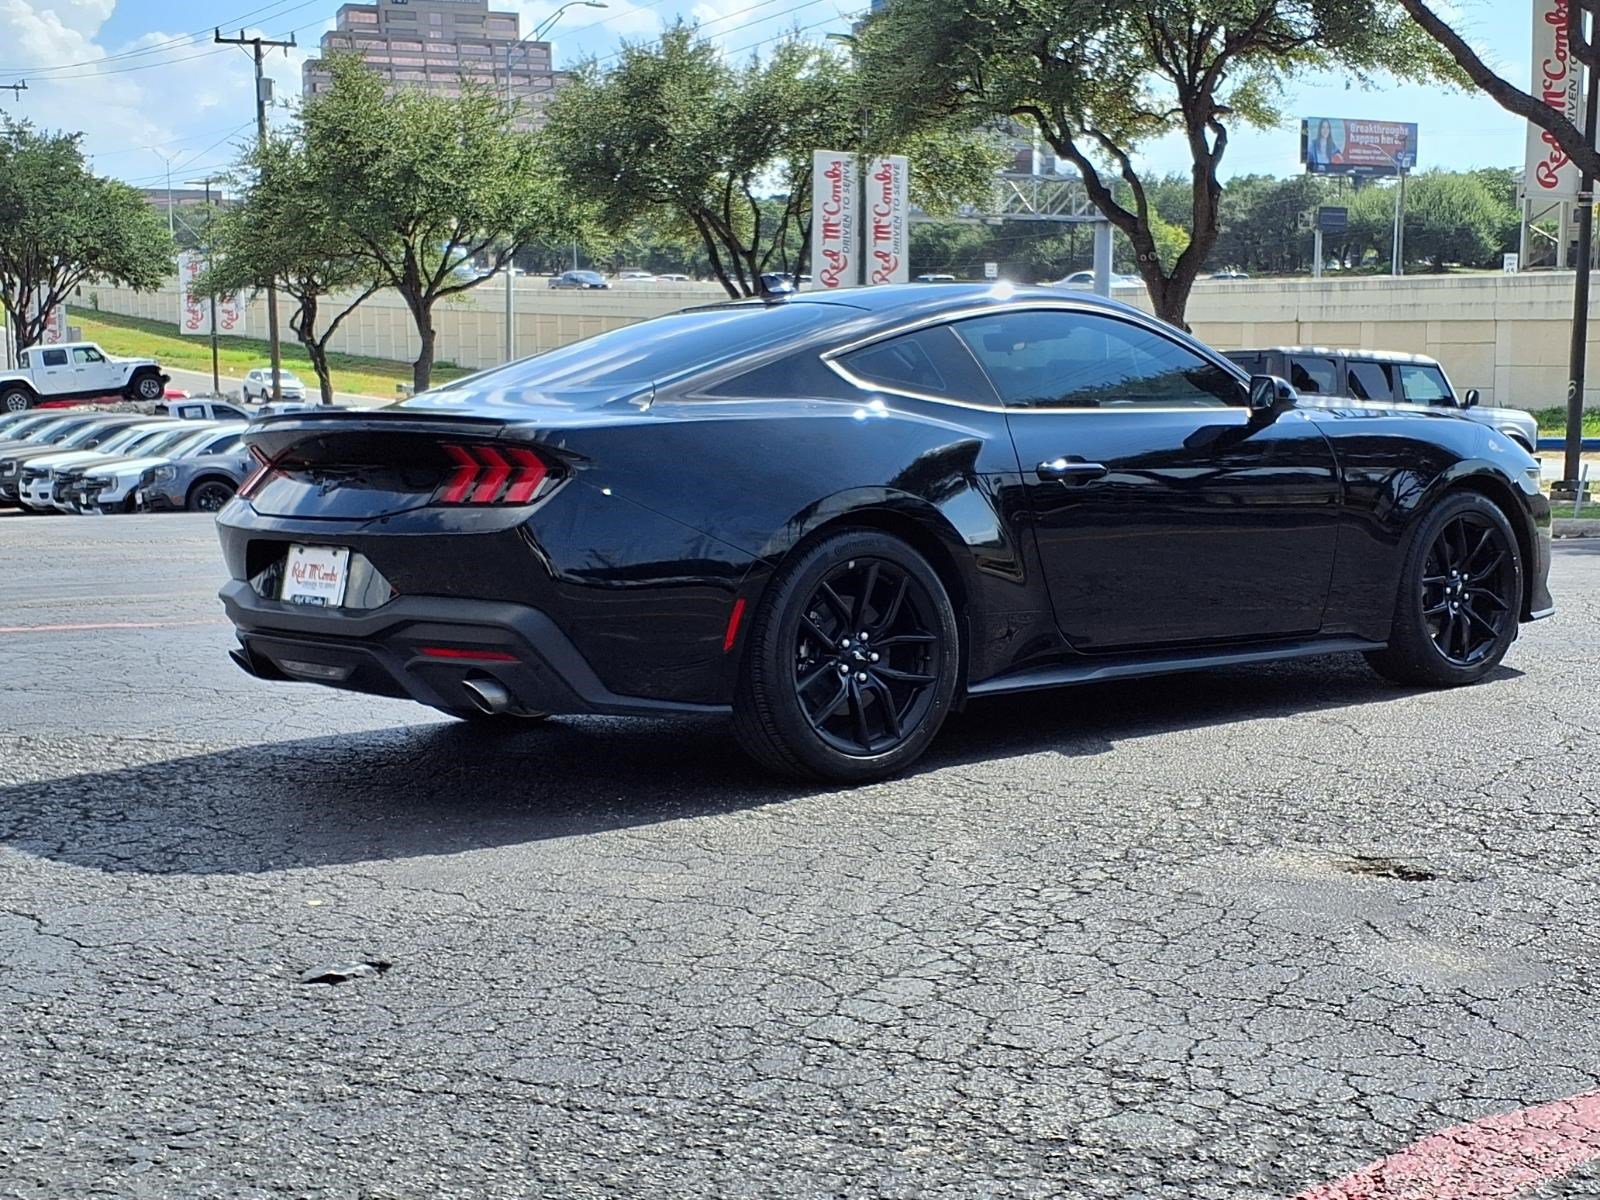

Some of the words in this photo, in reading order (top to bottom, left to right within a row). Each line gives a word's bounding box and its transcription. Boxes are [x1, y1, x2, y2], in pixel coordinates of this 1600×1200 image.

[1567, 80, 1578, 124] RIVEN
[1350, 123, 1409, 136] Breakthroughs
[1350, 133, 1379, 145] happen
[1536, 131, 1569, 189] Red
[822, 160, 842, 246] McCombs
[842, 196, 851, 211] TO
[872, 163, 893, 247] McCombs
[893, 198, 900, 212] TO
[842, 215, 851, 254] DRIVEN
[893, 216, 901, 255] DRIVEN
[820, 249, 848, 288] Red
[872, 250, 898, 284] Red
[186, 308, 204, 330] Red
[221, 308, 239, 330] Red
[291, 561, 307, 585] Red
